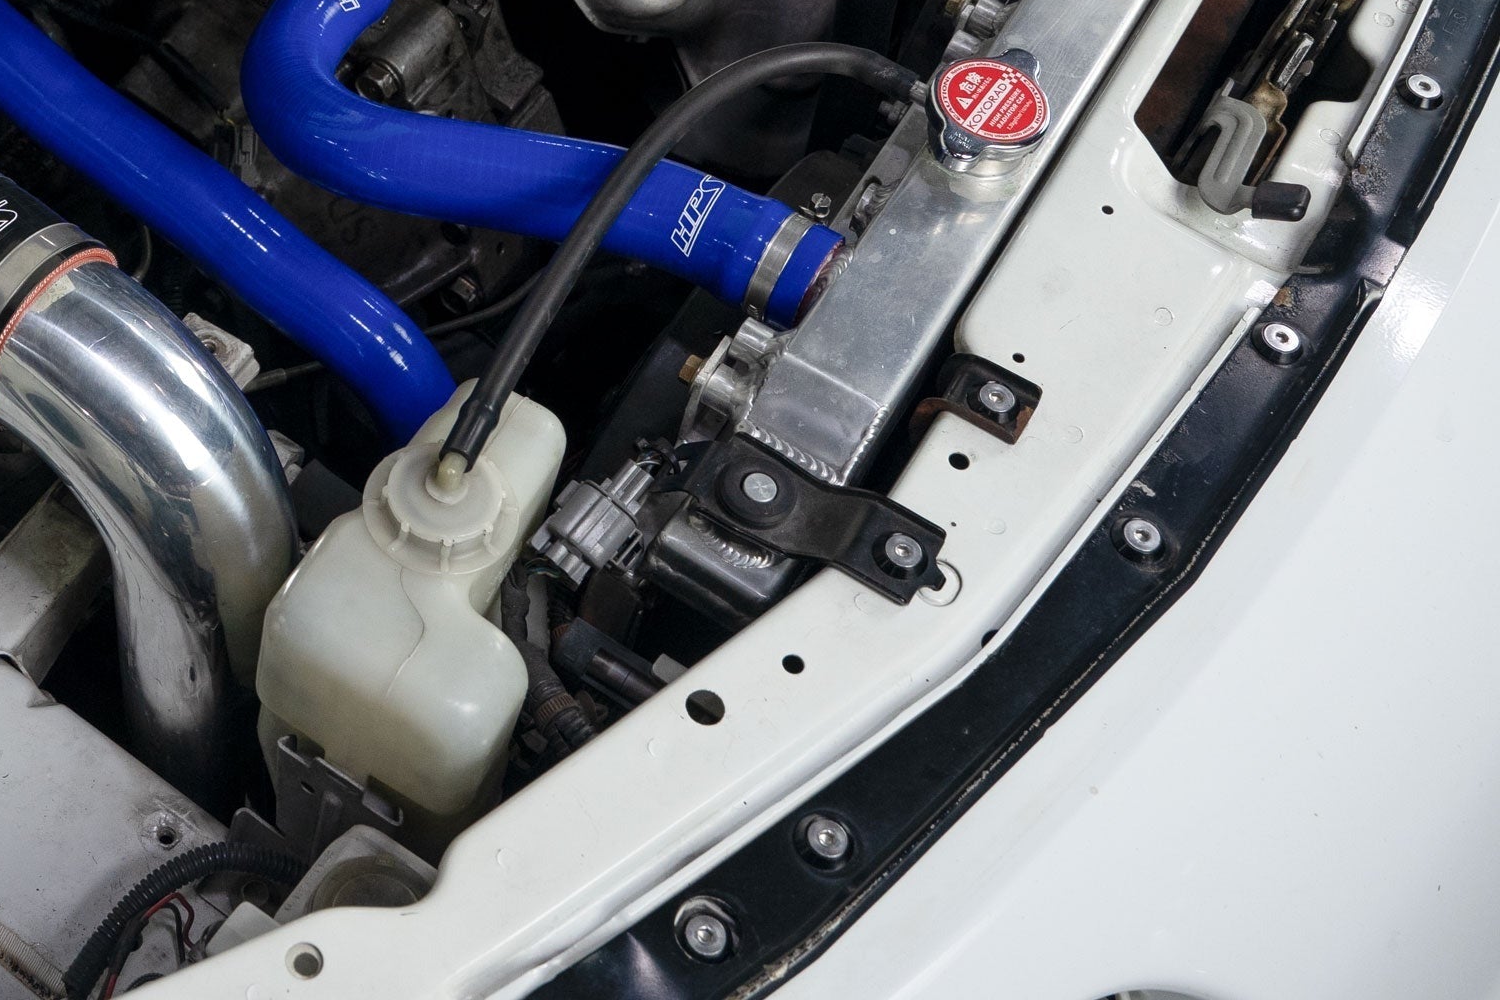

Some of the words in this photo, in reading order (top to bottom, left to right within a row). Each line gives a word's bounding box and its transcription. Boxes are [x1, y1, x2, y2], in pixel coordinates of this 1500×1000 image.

[957, 70, 984, 94] 危険
[966, 82, 1009, 129] KOYORAD
[988, 112, 1002, 126] HIGH
[999, 88, 1022, 113] PRESSURE
[996, 103, 1018, 128] RADIATOR
[1015, 93, 1026, 104] CAP
[669, 173, 726, 258] HPS
